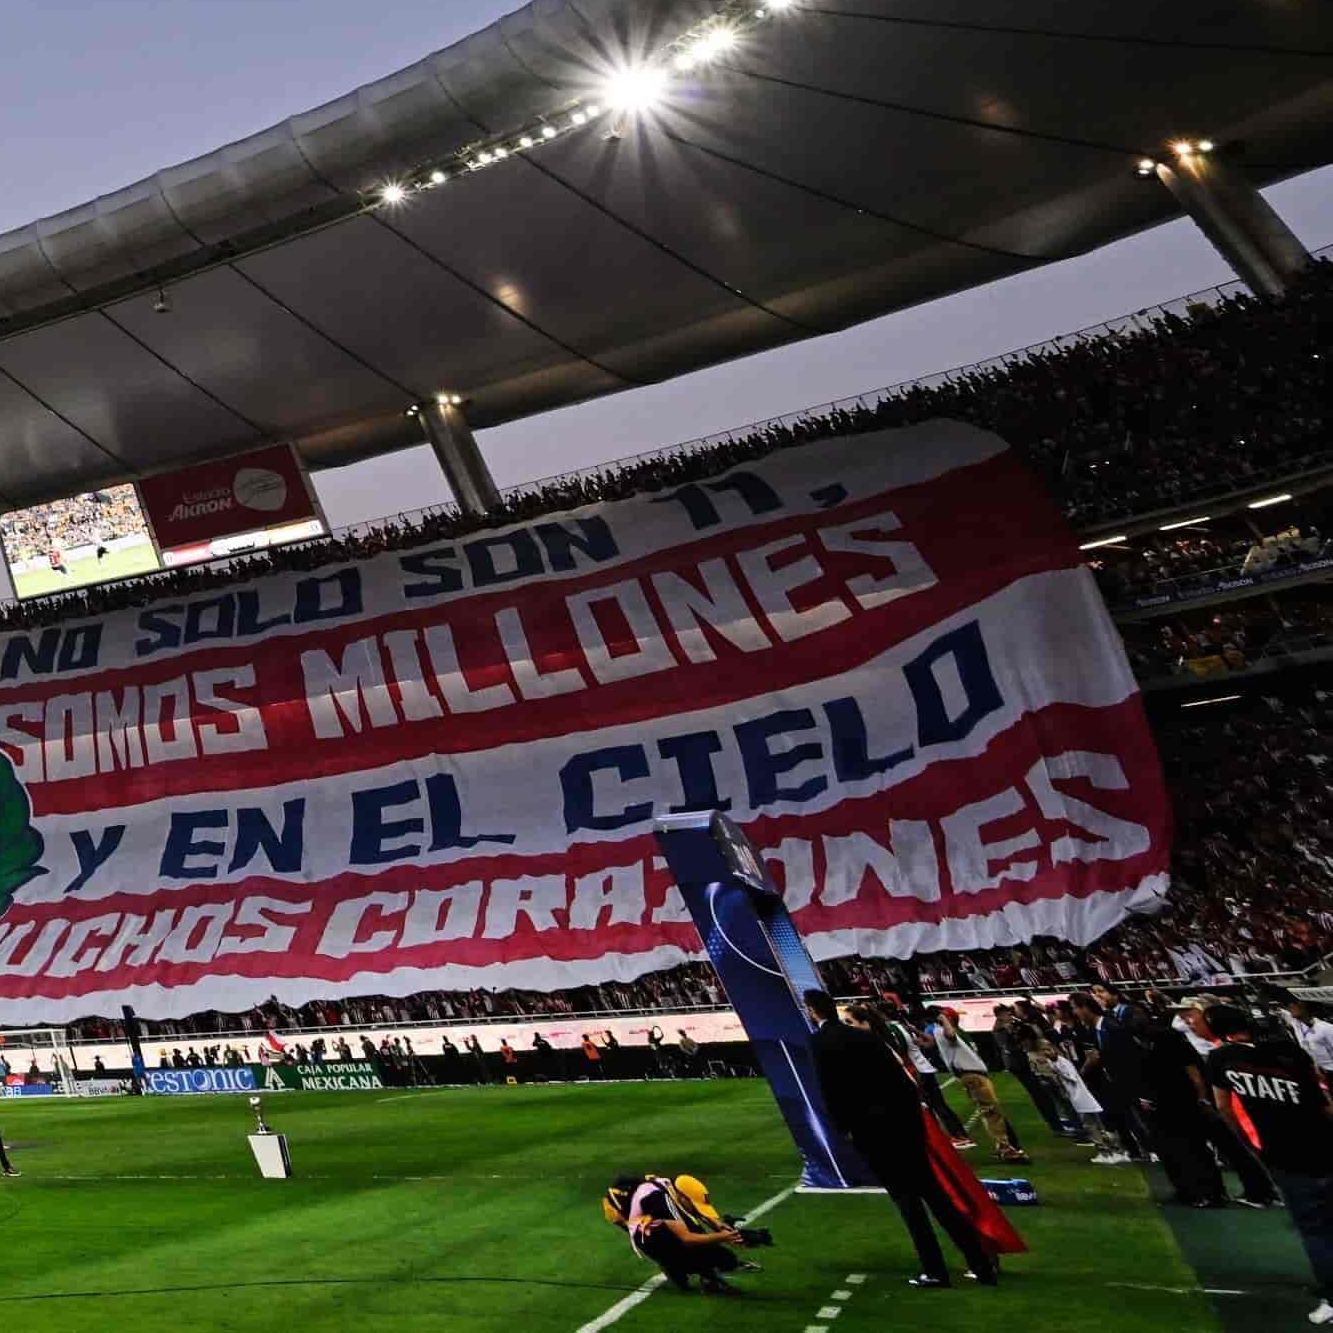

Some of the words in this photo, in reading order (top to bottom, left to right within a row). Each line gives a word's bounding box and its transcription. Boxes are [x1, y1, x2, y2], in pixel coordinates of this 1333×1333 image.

[0, 623, 101, 679] NO
[134, 566, 363, 655] SOLO
[403, 514, 618, 597] SON
[299, 511, 939, 739] MILLONES
[64, 825, 126, 892] Y
[158, 797, 305, 879] EN
[349, 773, 516, 866] EL
[559, 619, 1005, 834] CIELO
[297, 1065, 323, 1075] CAJA
[327, 1063, 374, 1074] POPULAR
[301, 1075, 383, 1091] MEXICANA
[1225, 1070, 1302, 1105] STAFF
